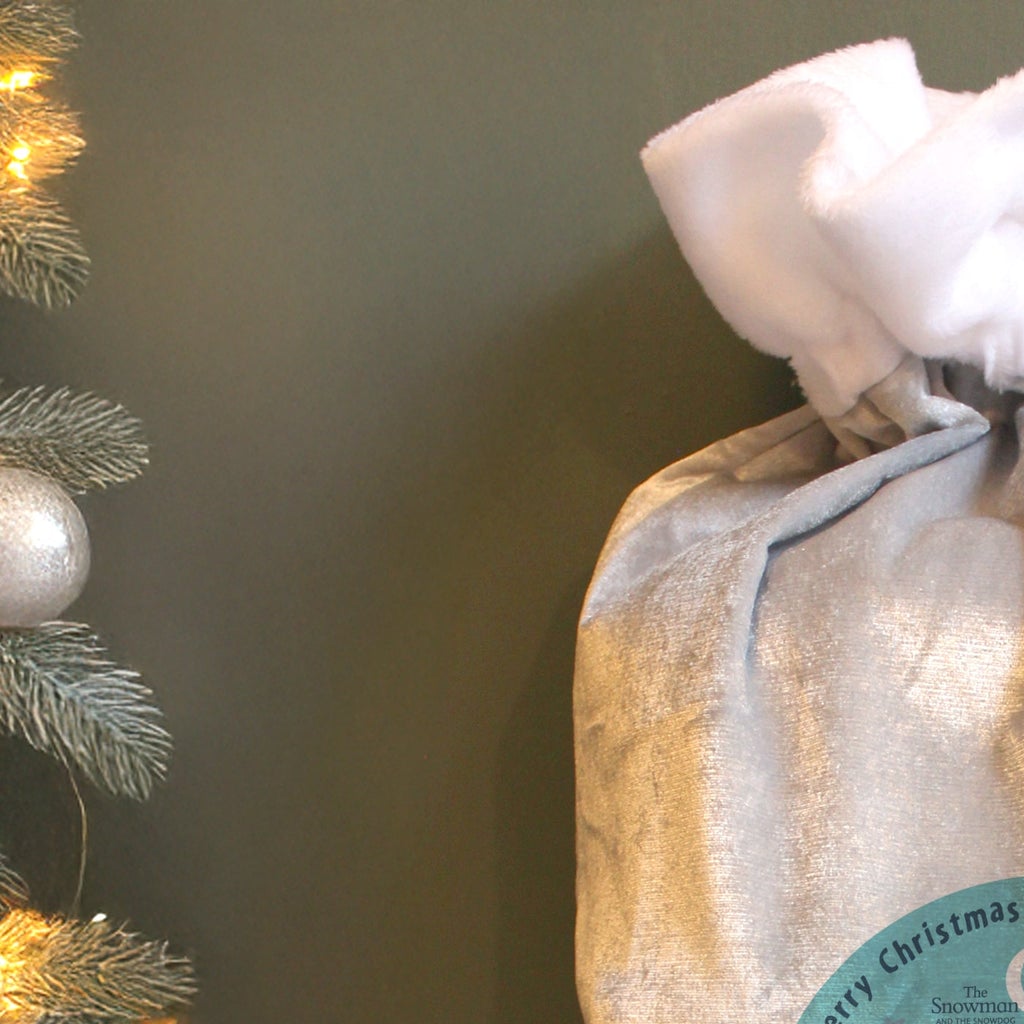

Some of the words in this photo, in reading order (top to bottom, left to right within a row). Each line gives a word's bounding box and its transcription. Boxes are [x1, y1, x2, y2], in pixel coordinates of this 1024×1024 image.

[879, 901, 1020, 974] Christmas
[963, 985, 988, 998] The
[931, 997, 1019, 1014] Snowman
[935, 1017, 953, 1024] AND
[955, 1017, 971, 1024] THE
[973, 1016, 1016, 1024] SNOWDOG
